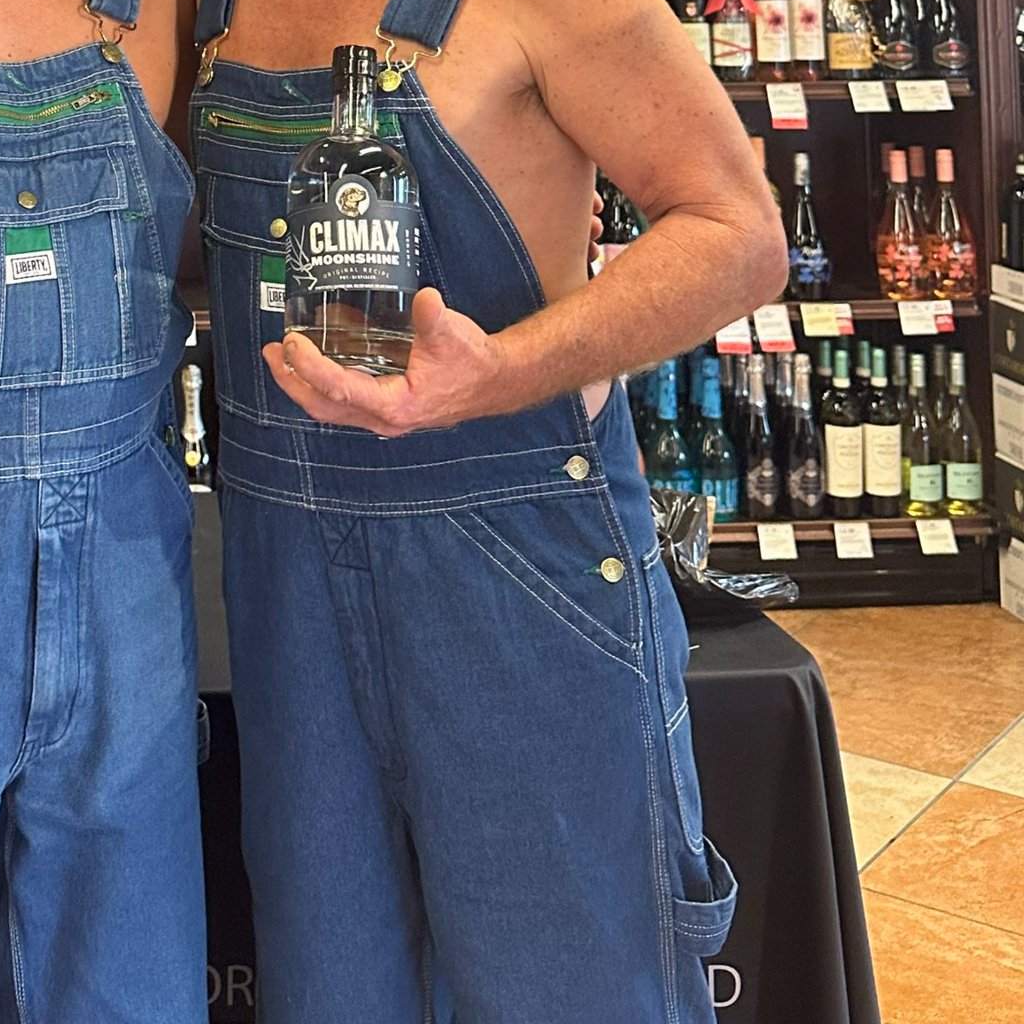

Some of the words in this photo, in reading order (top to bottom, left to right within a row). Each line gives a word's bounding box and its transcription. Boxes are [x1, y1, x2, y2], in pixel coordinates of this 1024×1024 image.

[309, 219, 400, 253] CLIMAX
[311, 253, 400, 266] MOONSHINE
[15, 259, 46, 275] LIBERTY
[323, 267, 359, 279] ORIGINAL
[362, 267, 390, 279] RECIPE
